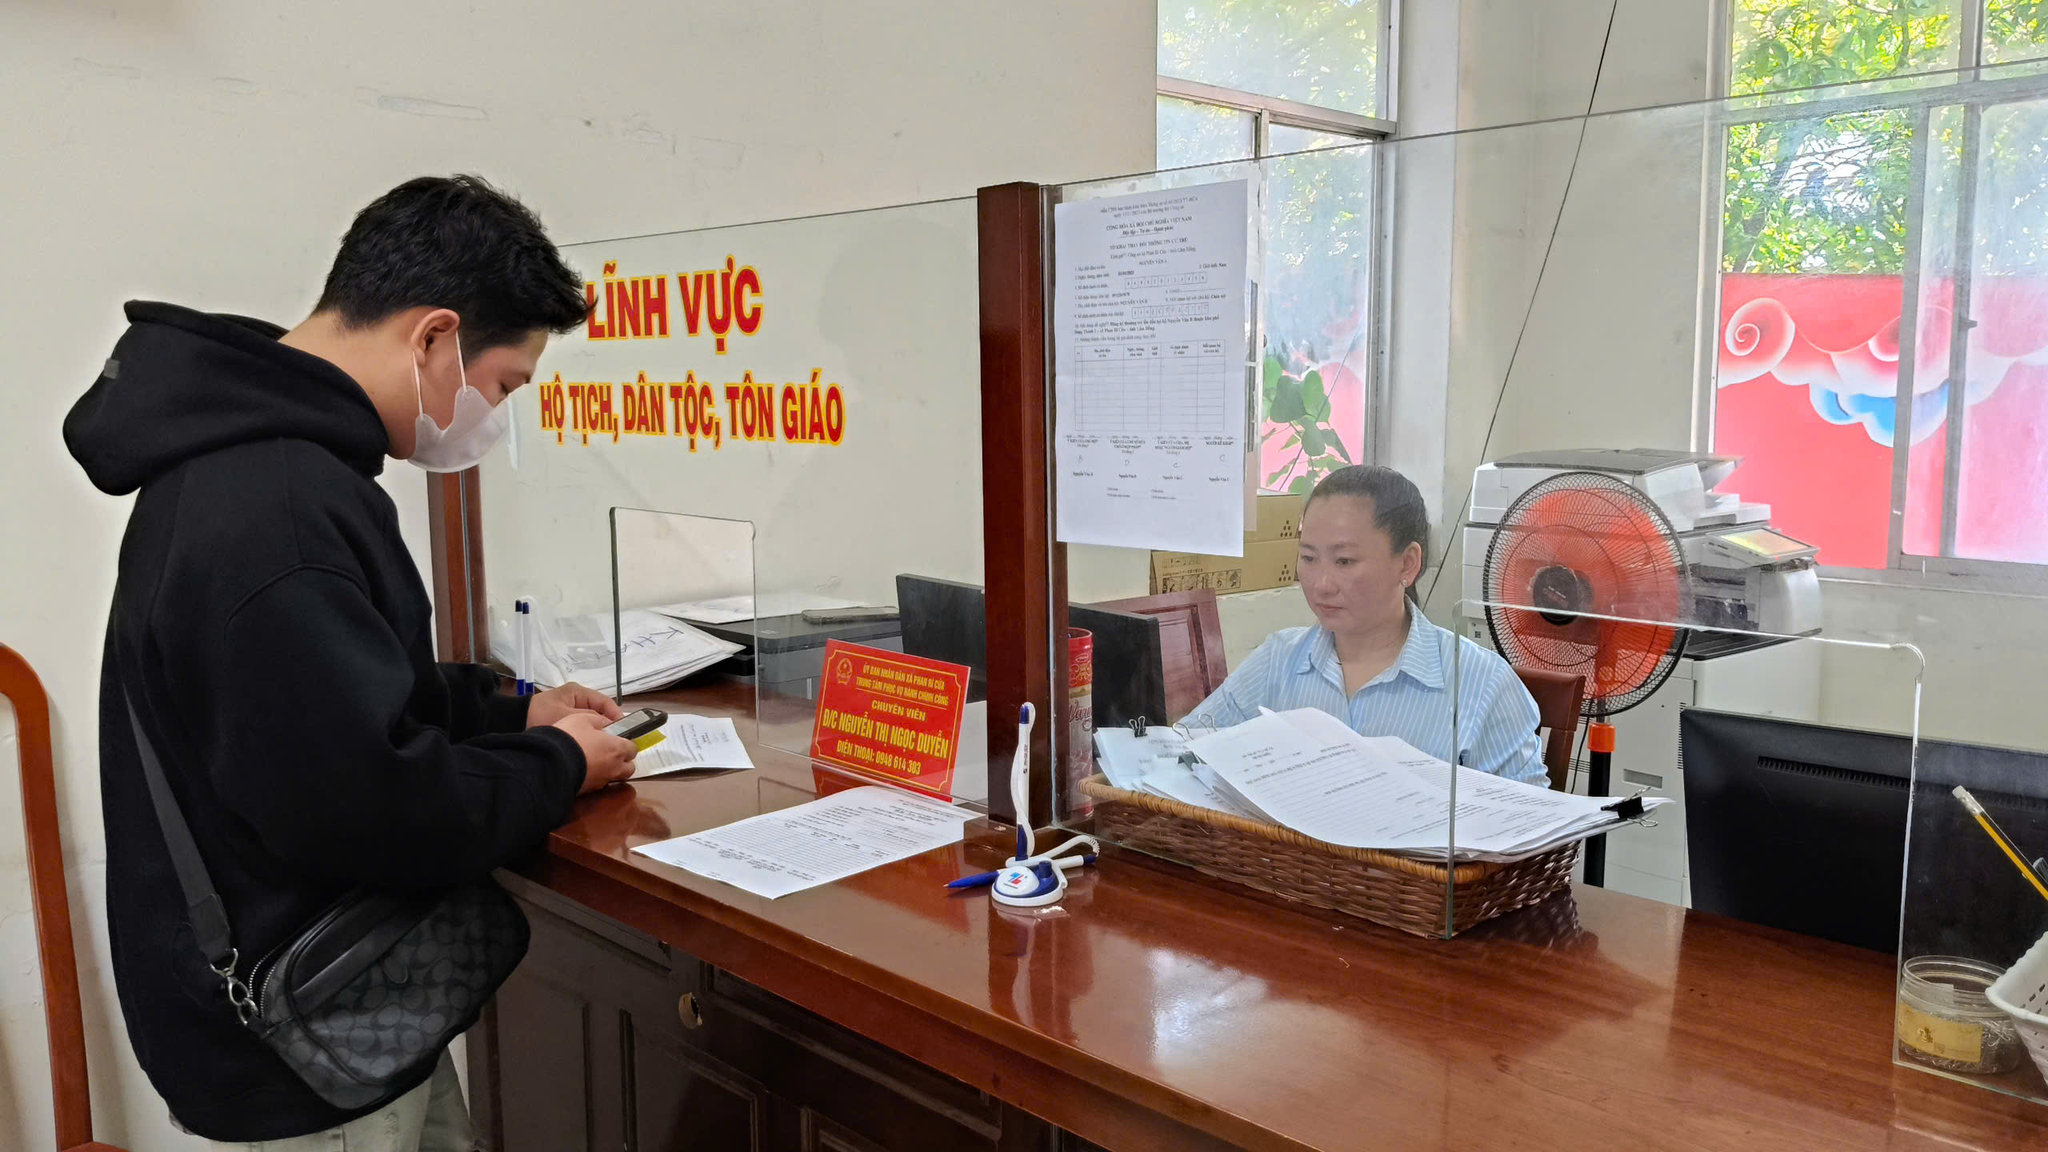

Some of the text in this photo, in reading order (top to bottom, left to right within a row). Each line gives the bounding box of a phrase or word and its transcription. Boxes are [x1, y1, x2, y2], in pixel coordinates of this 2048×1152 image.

[586, 254, 764, 354] LĨNH VỰC
[540, 367, 845, 452] HỘ TỊCH, DÂN TỘC, TÔN GIÁO
[823, 708, 838, 729] Đ/C
[838, 711, 874, 739] NGUYỄN
[874, 721, 890, 748] THỊ
[889, 725, 916, 753] NGỌC
[871, 699, 926, 721] CHUYÊN VIÊN
[836, 739, 853, 758] ĐIỆN
[854, 744, 875, 763] THOẠI:
[875, 750, 892, 767] 0948
[893, 754, 907, 771] 614
